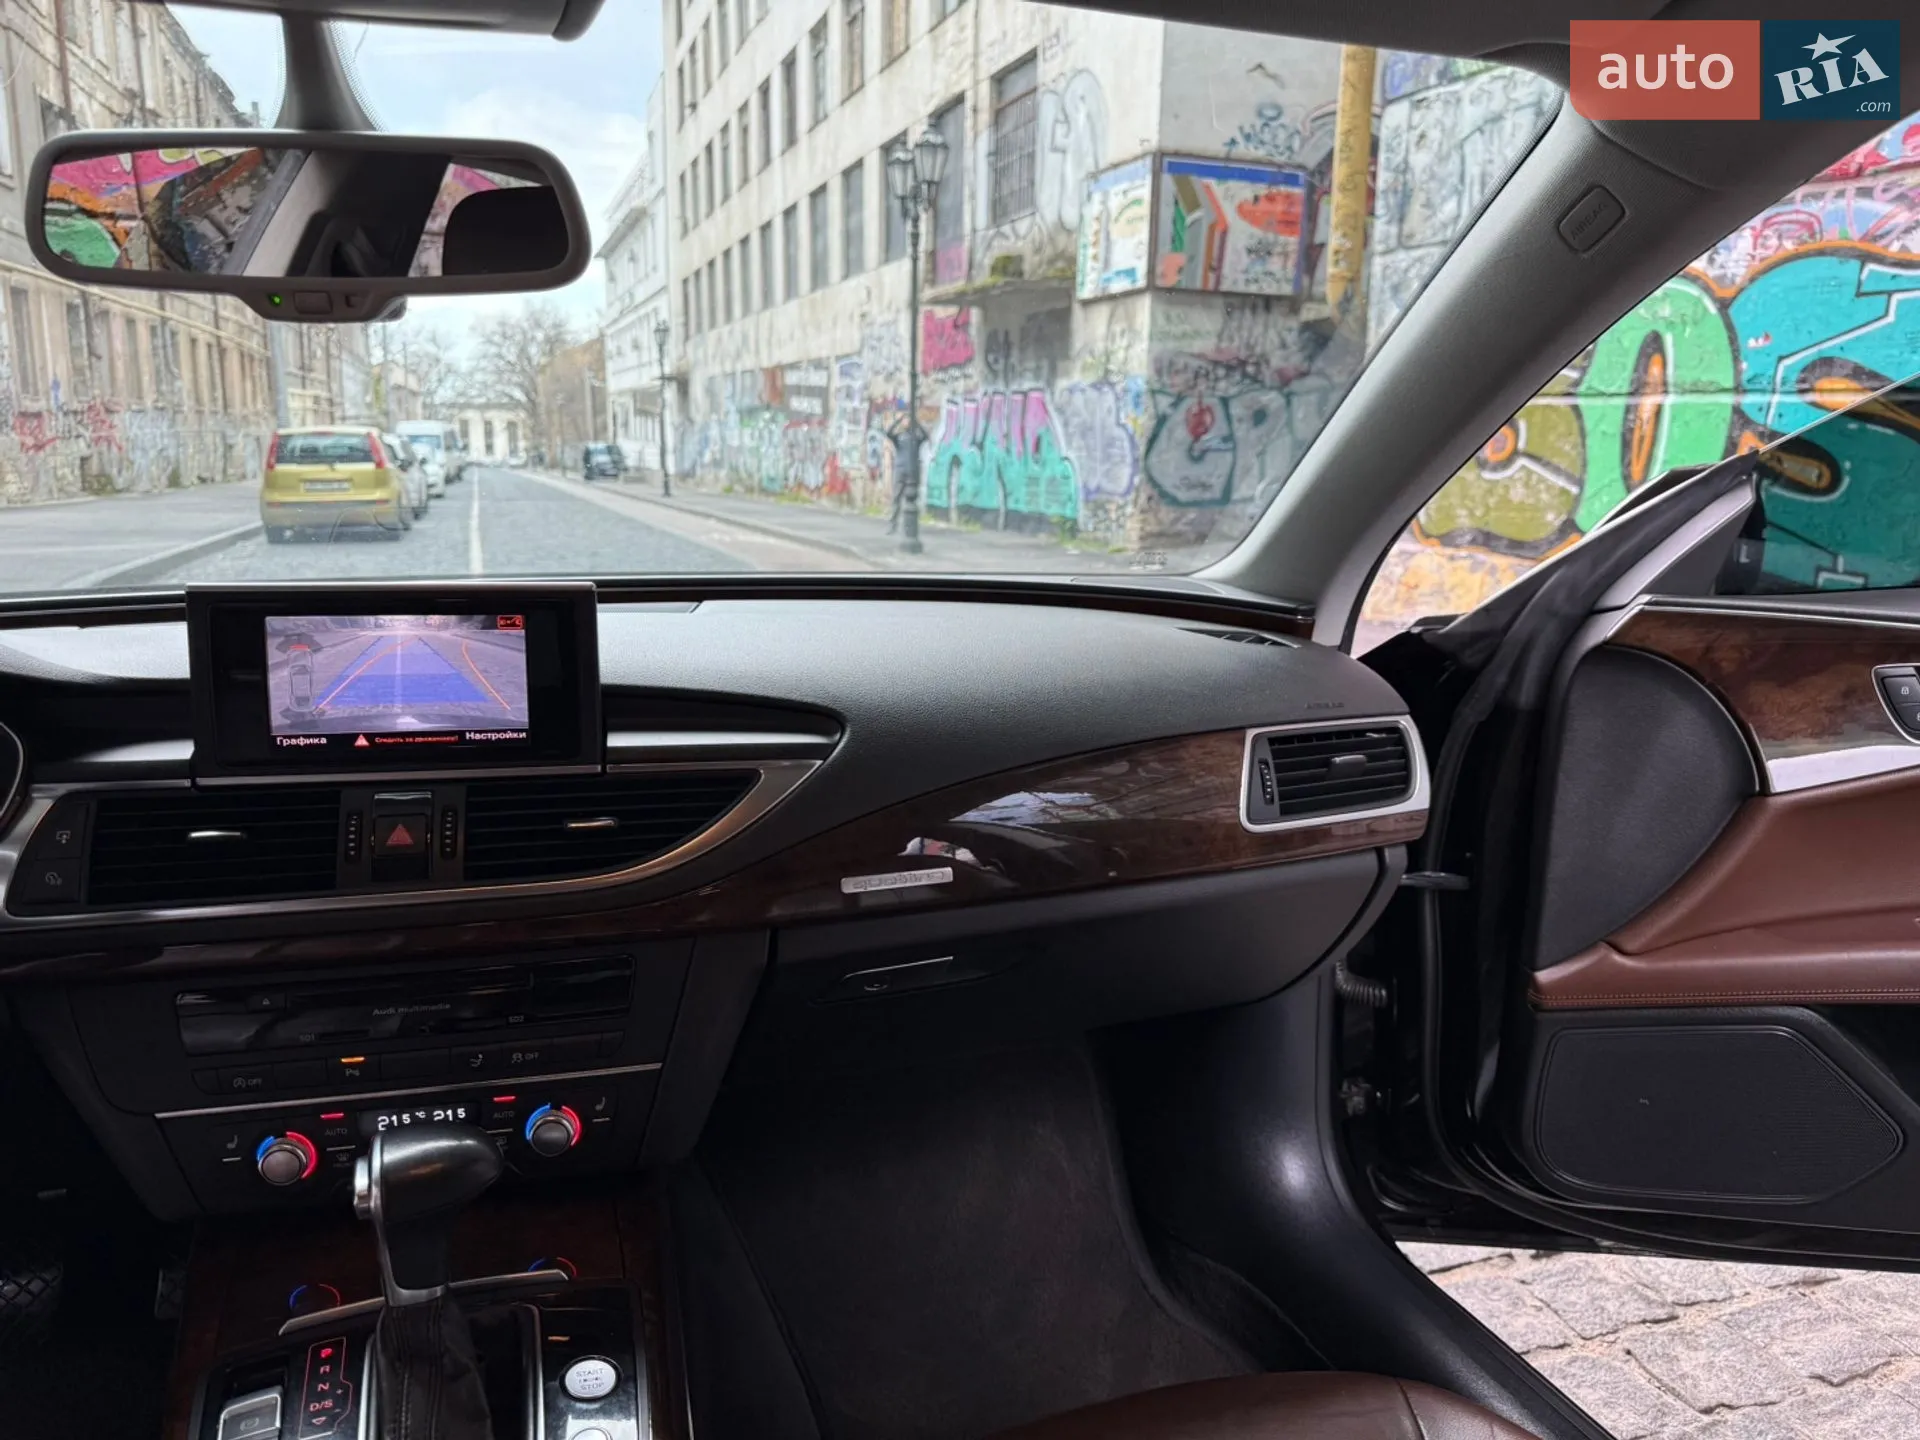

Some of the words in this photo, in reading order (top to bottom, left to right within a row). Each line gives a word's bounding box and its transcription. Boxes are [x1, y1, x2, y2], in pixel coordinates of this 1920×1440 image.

[465, 728, 527, 741] Настройки
[276, 735, 328, 748] Графика
[371, 1006, 396, 1017] Audi
[492, 1111, 516, 1120] AUTO
[323, 1127, 348, 1136] AUTO
[575, 1367, 605, 1378] START
[317, 1382, 330, 1392] N
[579, 1382, 605, 1391] STOP
[309, 1399, 333, 1412] D/S
